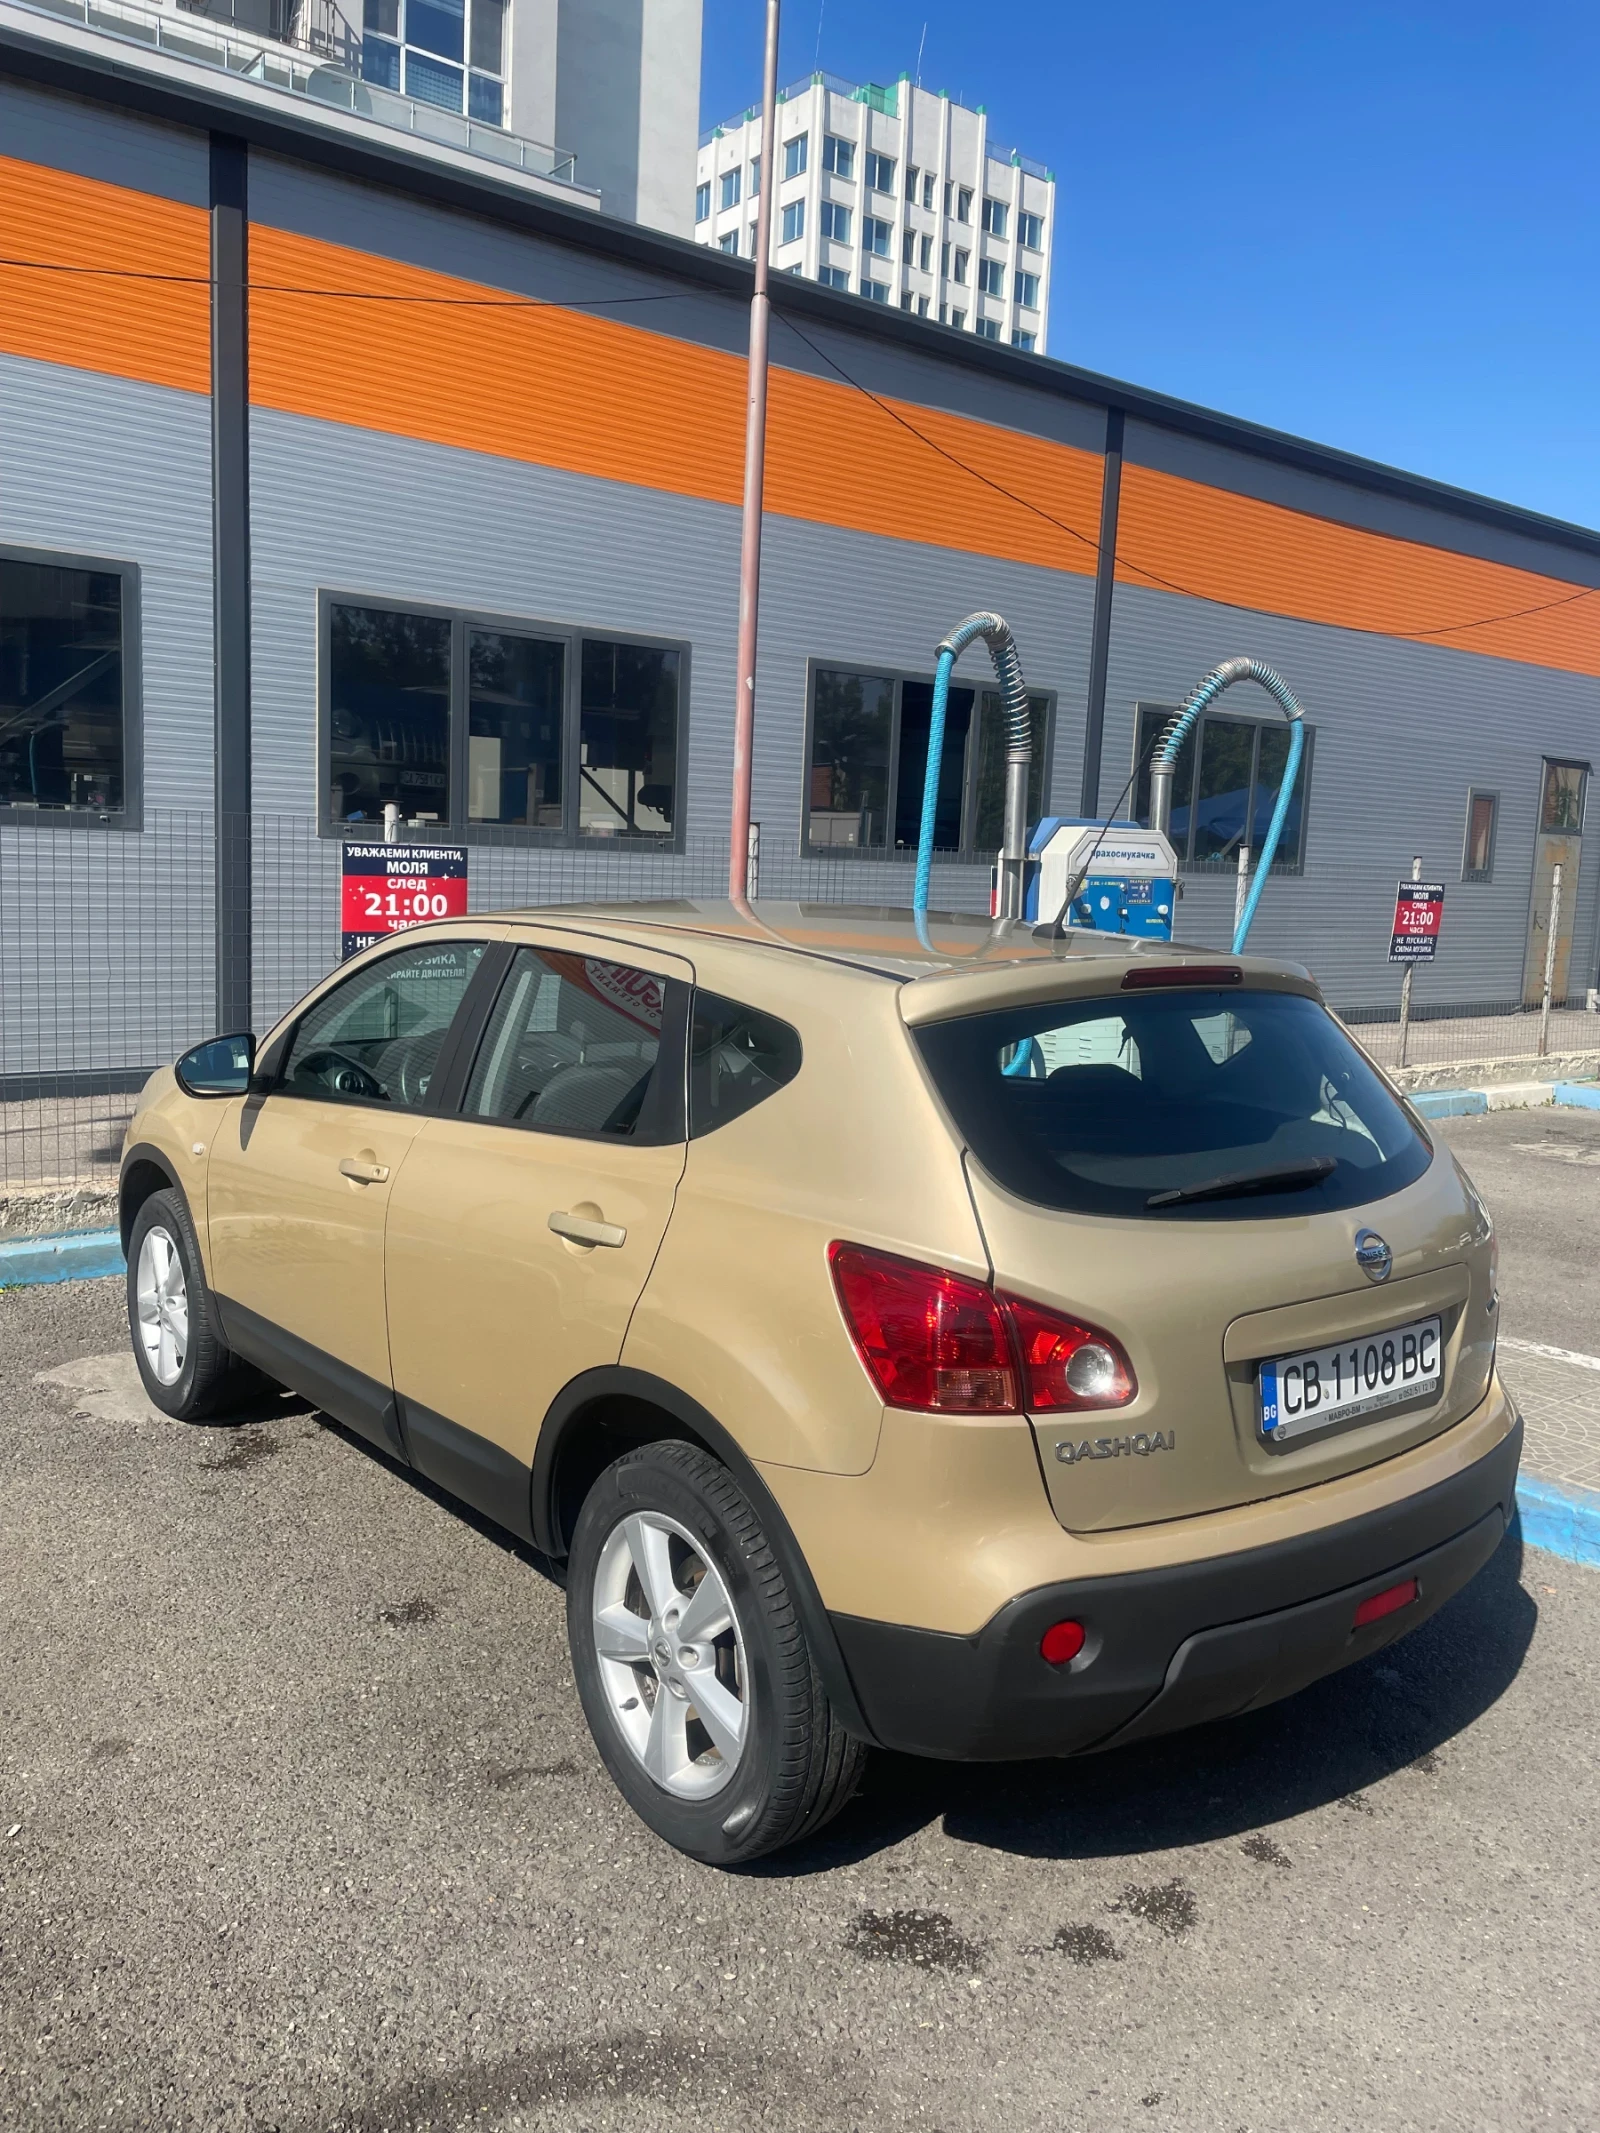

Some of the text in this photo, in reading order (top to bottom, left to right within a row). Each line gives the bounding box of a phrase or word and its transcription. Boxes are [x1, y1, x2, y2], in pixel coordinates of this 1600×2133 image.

[347, 847, 463, 861] УВАЖАЕМИ КЛИЕНТИ,
[386, 862, 428, 874] МОЛЯ
[387, 878, 427, 891] след
[1413, 892, 1429, 900] МОЛЯ
[365, 893, 448, 916] 21:00
[1412, 902, 1427, 910] след
[1402, 911, 1433, 925] 21:00
[387, 968, 465, 979] ИРАЙТЕ ДВИГАТЕЛЯ!
[1263, 1404, 1277, 1421] BG
[1055, 1430, 1175, 1464] QASHQAI
